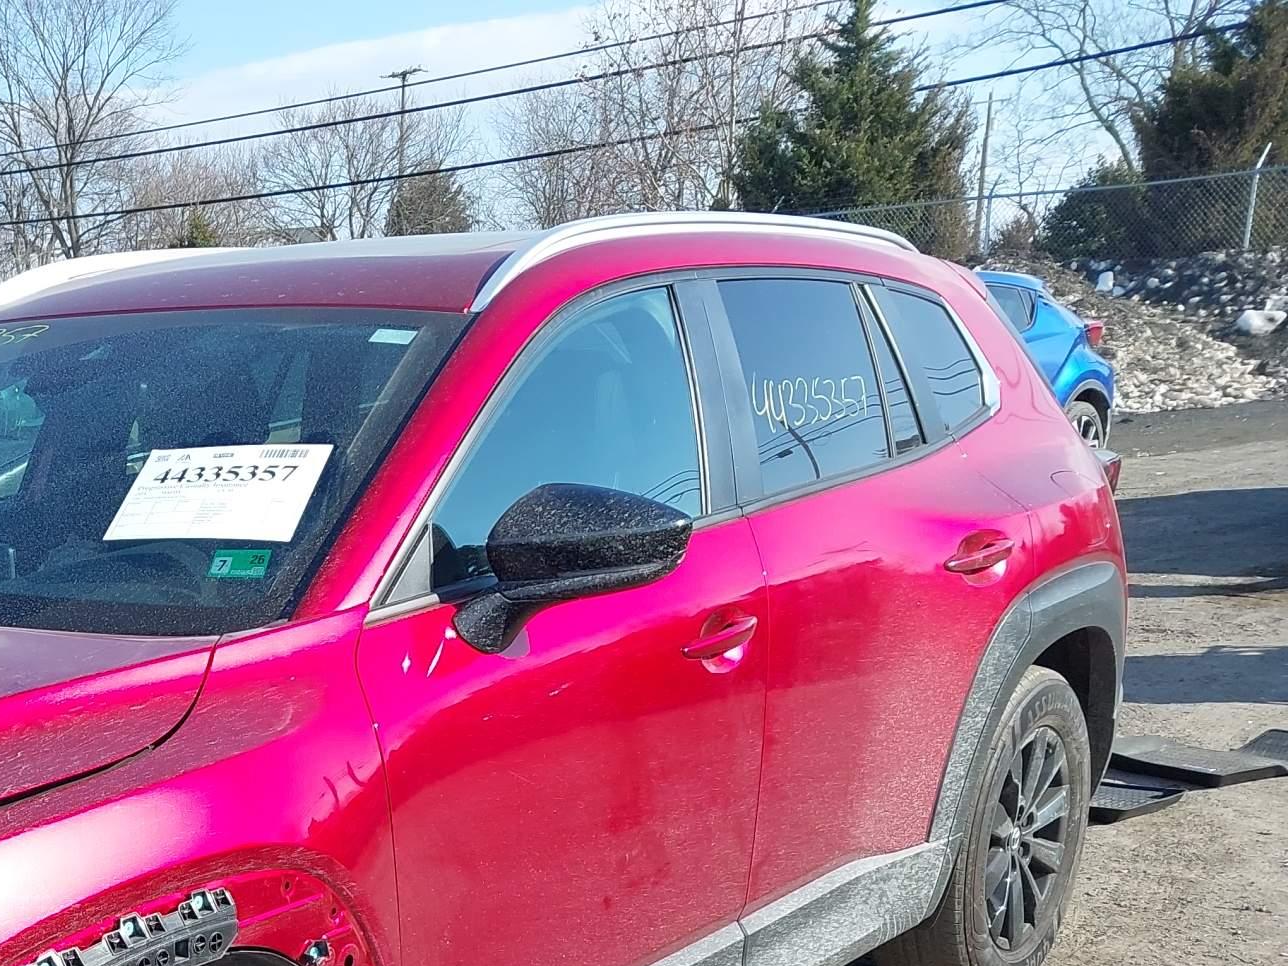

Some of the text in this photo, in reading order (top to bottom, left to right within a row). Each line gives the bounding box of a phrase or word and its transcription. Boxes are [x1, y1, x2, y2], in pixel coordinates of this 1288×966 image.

[752, 371, 870, 433] 44335357
[152, 464, 299, 484] 44335357
[217, 559, 228, 572] 7
[249, 554, 266, 565] 26
